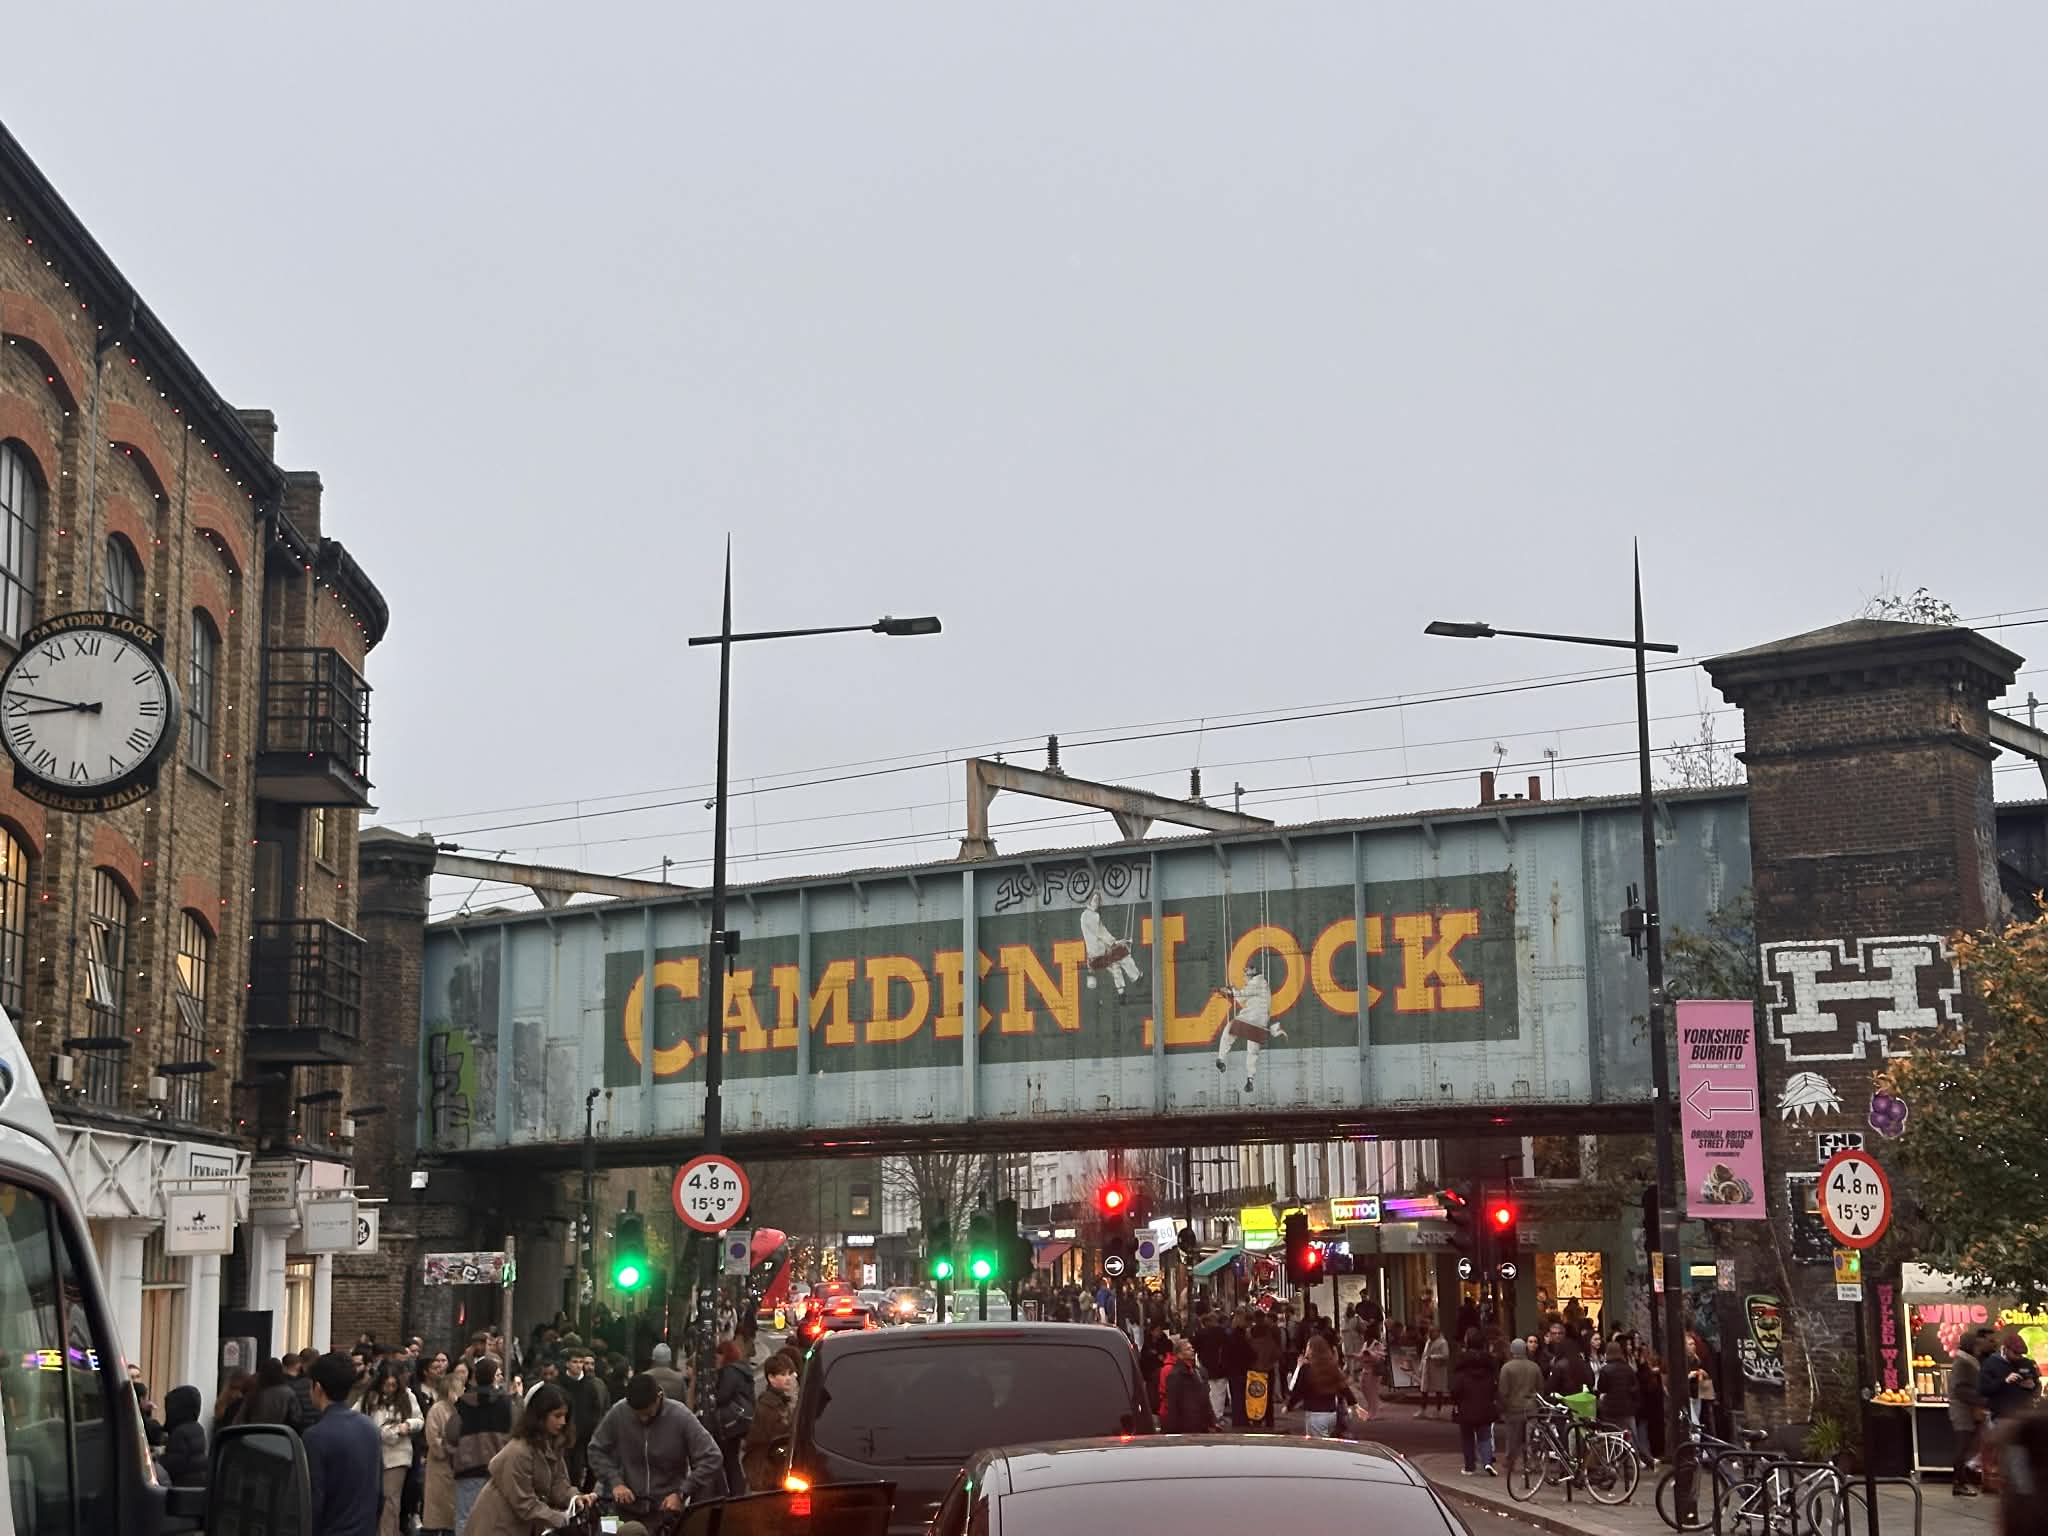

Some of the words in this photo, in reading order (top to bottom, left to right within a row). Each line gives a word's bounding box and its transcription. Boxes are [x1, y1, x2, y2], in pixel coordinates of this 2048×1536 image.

[29, 614, 105, 642] CAMDEN
[111, 614, 158, 645] LOCK
[74, 637, 100, 656] XII
[103, 783, 150, 809] HALL
[624, 940, 1087, 1076] CAMDEN
[1142, 908, 1482, 1048] LOCK
[1683, 1028, 1751, 1045] YORKSHIRE
[1691, 1044, 1744, 1060] BURRITO
[1691, 1129, 1723, 1140] ORIGINAL
[1725, 1129, 1754, 1140] BRITISH
[1819, 1133, 1862, 1147] END
[1698, 1139, 1724, 1149] STREET
[1726, 1139, 1745, 1149] FOOD
[689, 1174, 719, 1190] 4.8
[723, 1180, 737, 1190] m
[1833, 1173, 1862, 1194] 4.8
[1866, 1183, 1878, 1195] m
[1335, 1204, 1378, 1218] TATTOO
[1918, 1303, 1989, 1323] wine
